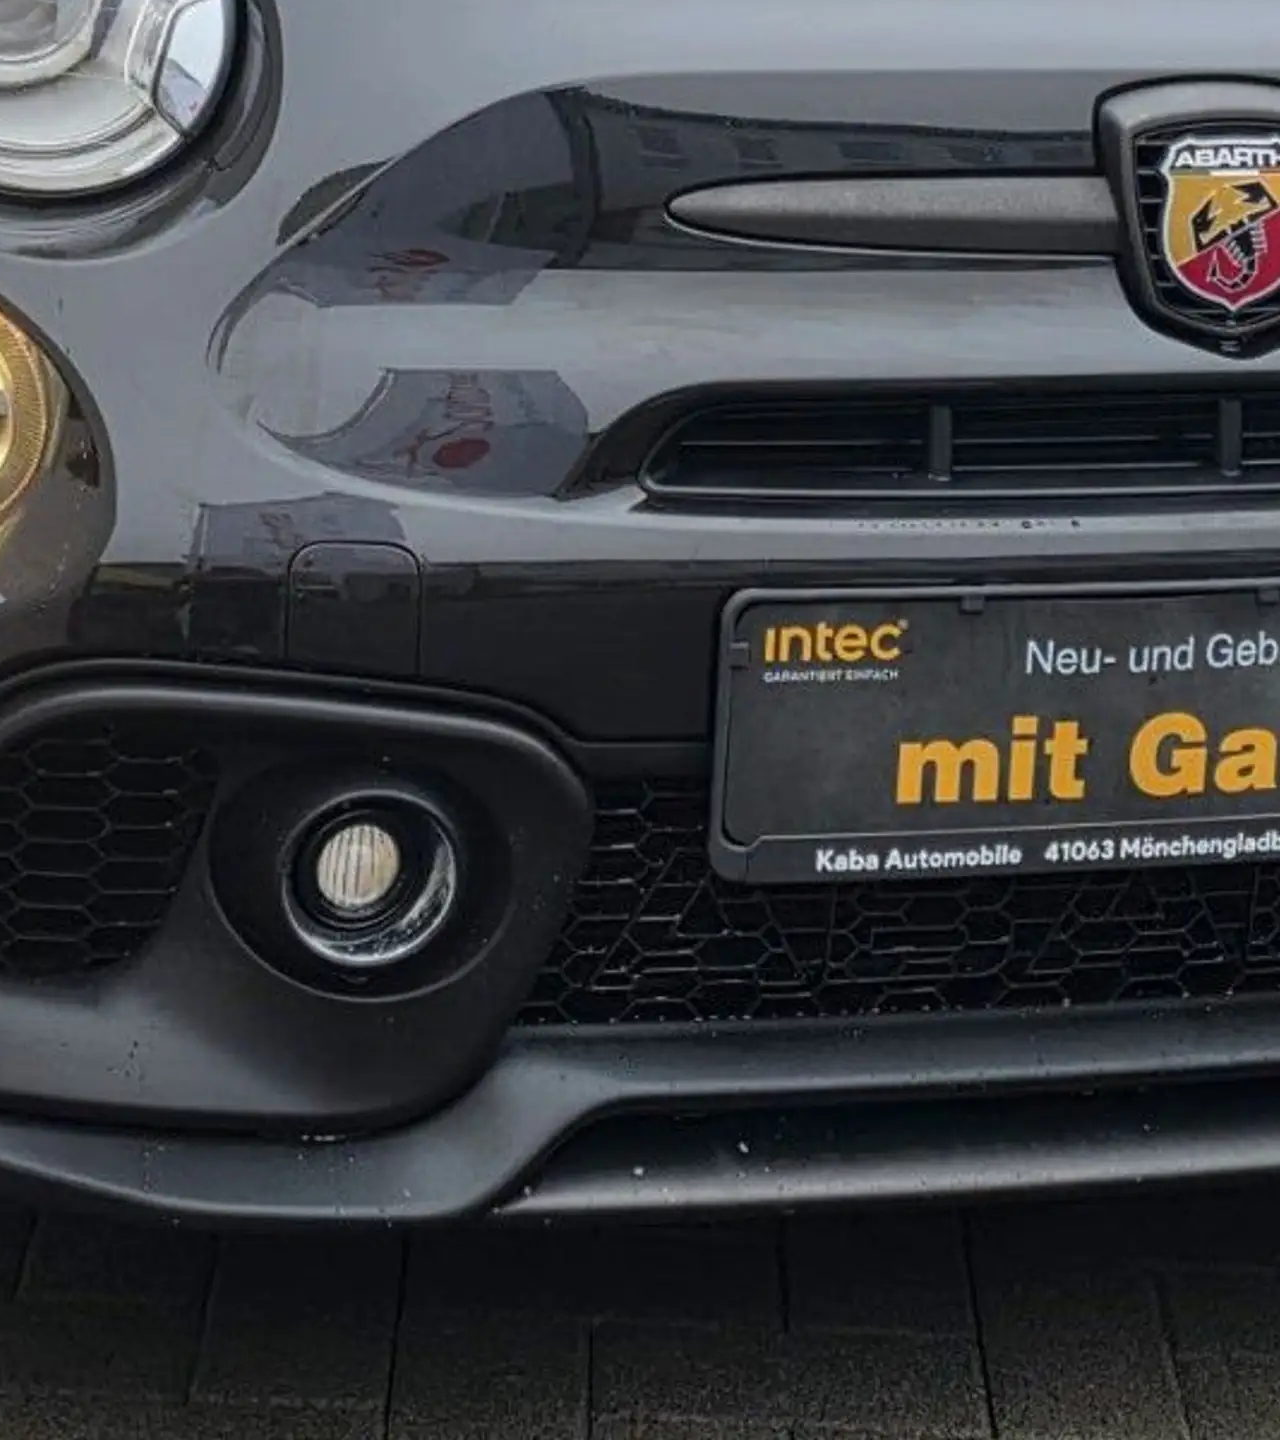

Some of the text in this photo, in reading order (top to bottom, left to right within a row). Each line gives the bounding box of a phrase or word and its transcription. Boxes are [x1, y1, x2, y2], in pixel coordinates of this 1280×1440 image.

[1024, 640, 1116, 675] Neu-
[1128, 636, 1195, 673] und
[895, 715, 1089, 805] mit
[815, 848, 880, 872] Kaba
[884, 843, 1022, 871] Automobile
[1044, 839, 1114, 863] 41063
